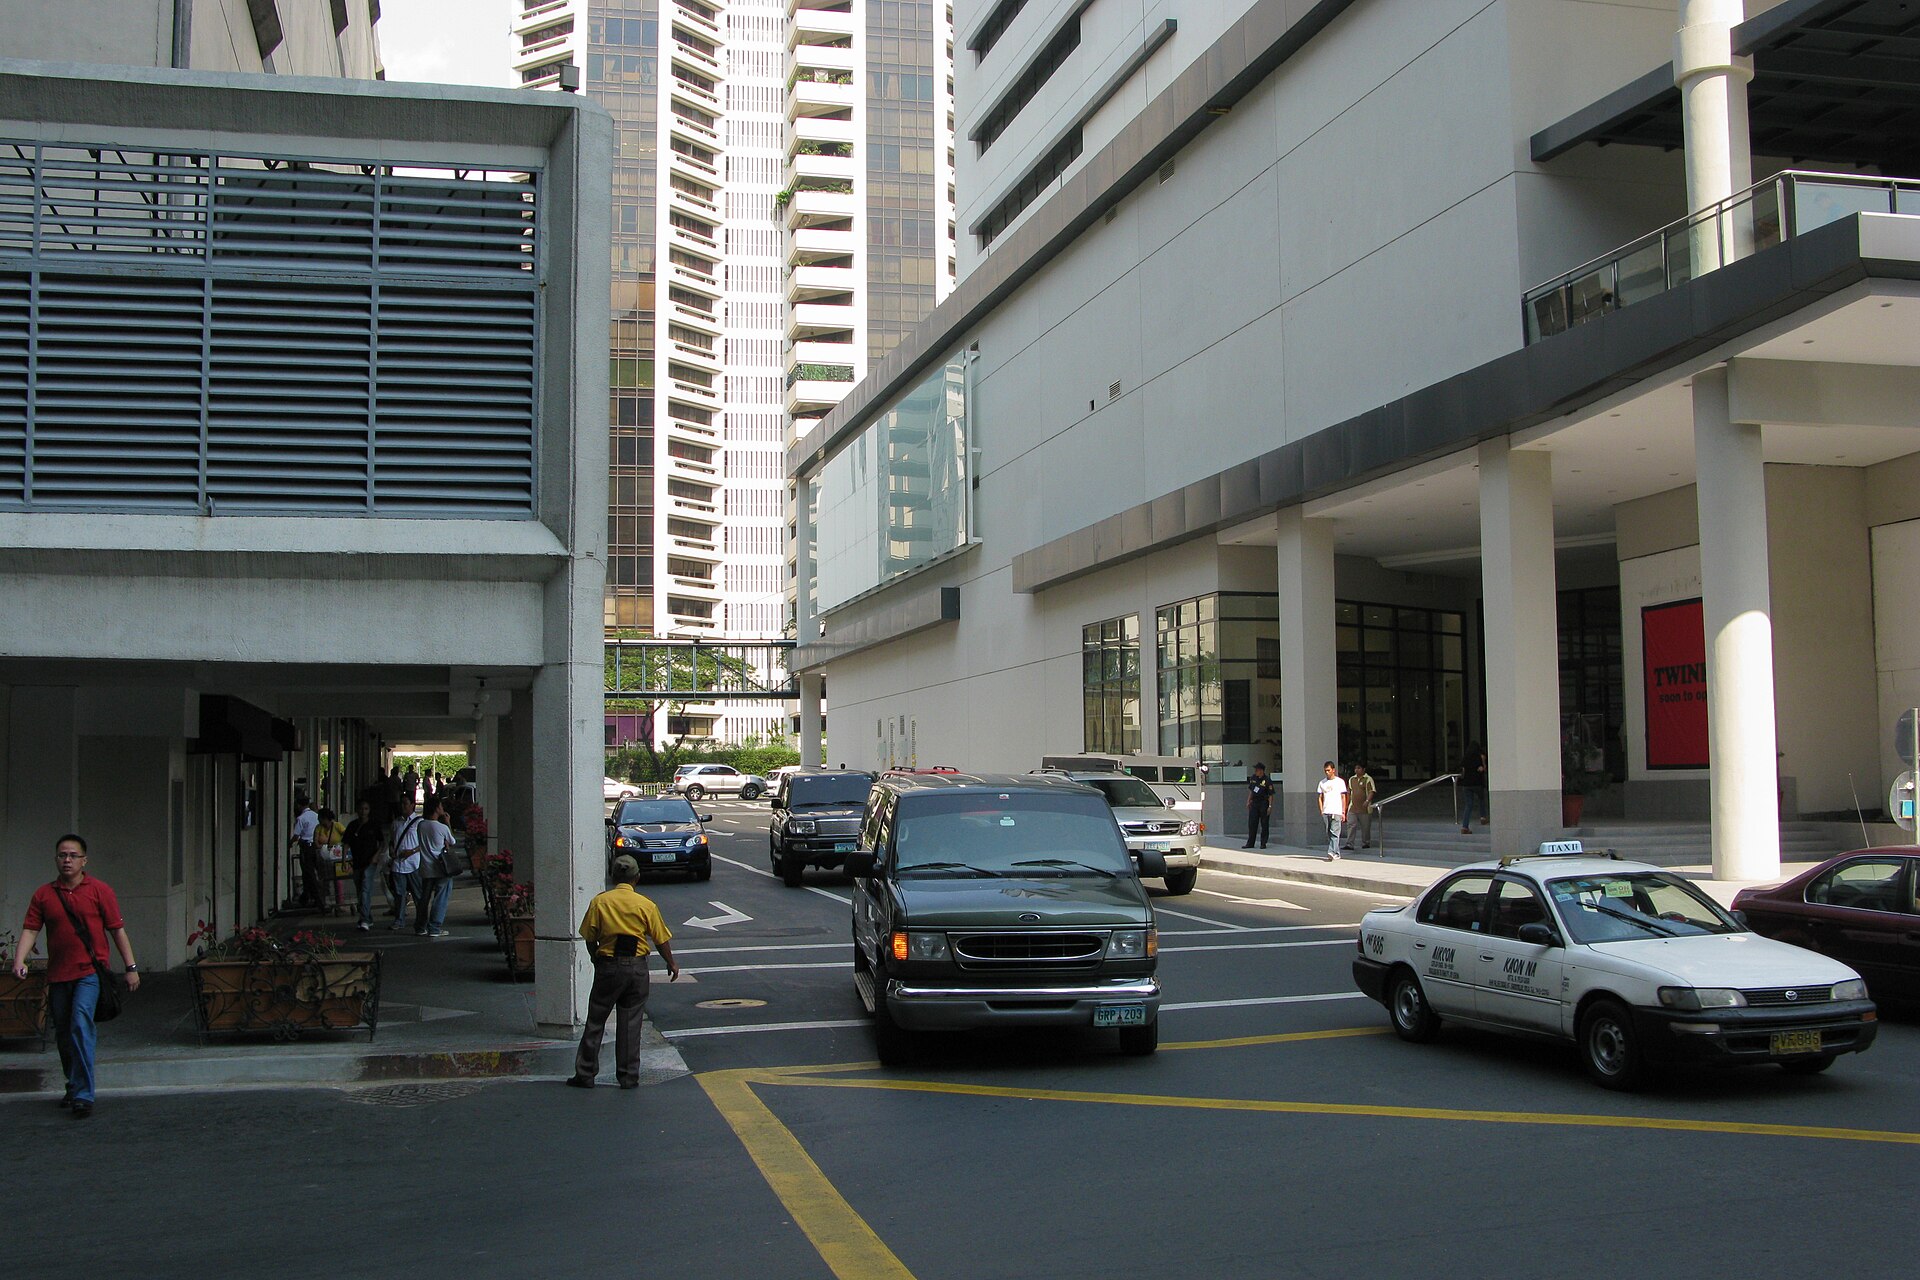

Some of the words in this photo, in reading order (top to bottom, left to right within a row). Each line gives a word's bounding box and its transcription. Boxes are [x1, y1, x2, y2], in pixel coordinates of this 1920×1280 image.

[1660, 693, 1680, 703] soon
[1683, 690, 1693, 701] to
[1432, 945, 1456, 963] AIRCON
[1503, 957, 1525, 975] KAON
[1525, 961, 1538, 977] NA
[1097, 1009, 1116, 1022] GRP
[1124, 1008, 1143, 1020] 203
